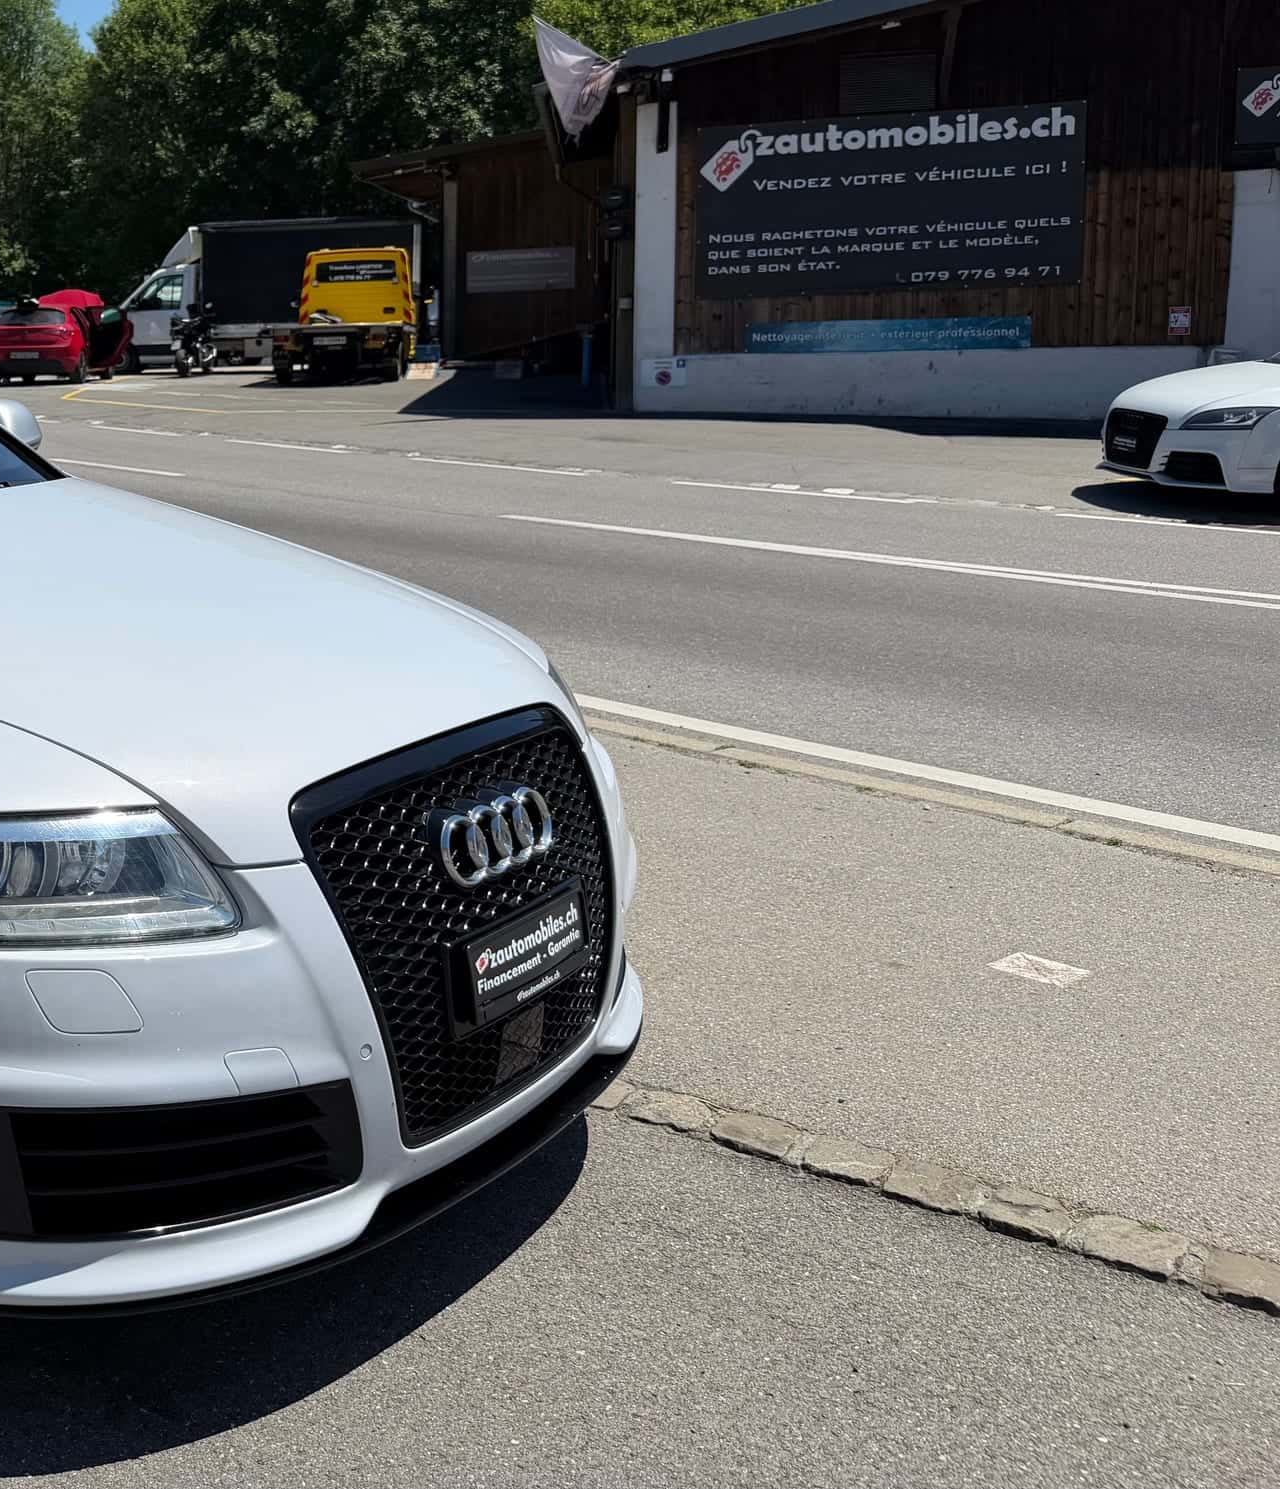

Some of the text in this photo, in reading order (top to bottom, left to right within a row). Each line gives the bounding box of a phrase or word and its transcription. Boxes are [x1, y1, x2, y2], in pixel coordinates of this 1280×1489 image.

[754, 107, 1076, 156] zautomobiles.ch
[1061, 161, 1068, 174] !
[911, 265, 1061, 282] 079 776 94 71
[752, 331, 811, 344] Nettoyage
[937, 325, 1020, 340] professionnel
[489, 902, 578, 969] zautomobiles.ch
[477, 954, 542, 995] Financement
[547, 928, 580, 957] Garantie
